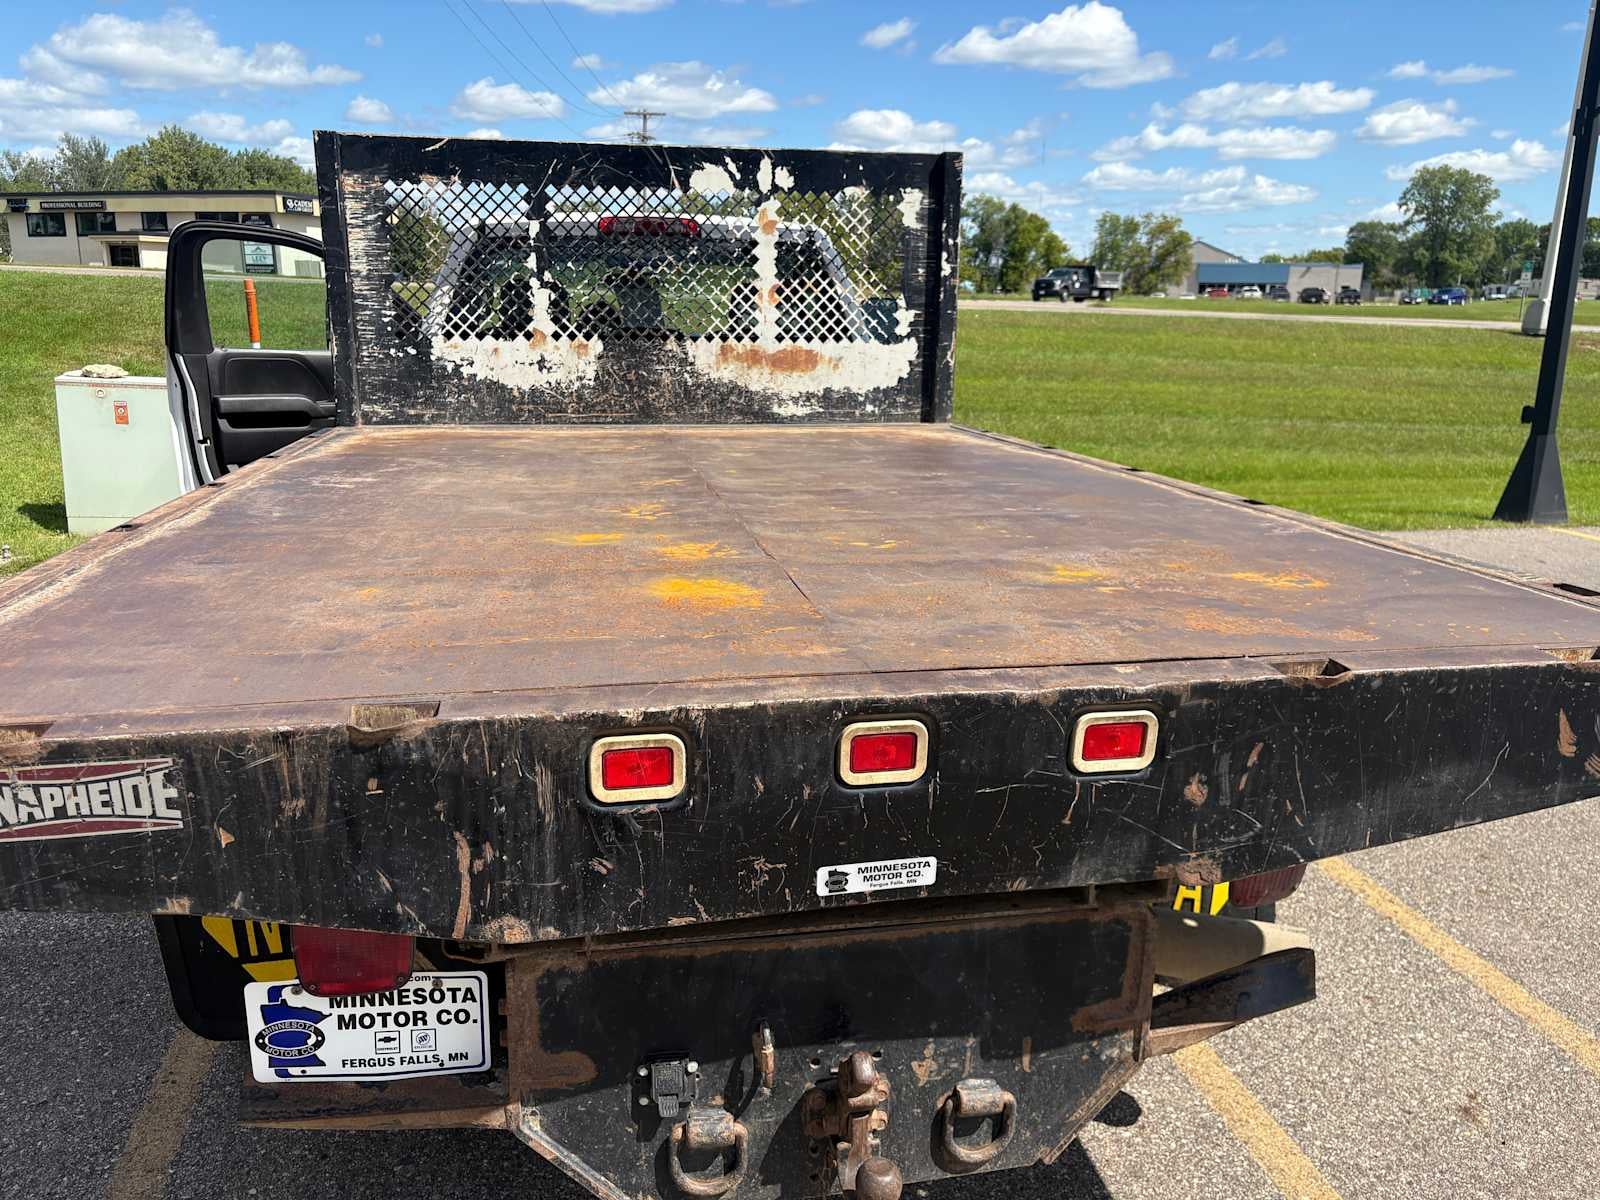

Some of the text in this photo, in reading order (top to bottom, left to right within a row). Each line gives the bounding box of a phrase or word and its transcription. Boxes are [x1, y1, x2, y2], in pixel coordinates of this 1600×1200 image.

[857, 861, 931, 874] MINNESOTA
[863, 870, 924, 882] MOTOR CO.
[329, 987, 478, 1008] MINNESOTA
[337, 1008, 478, 1030] MOTOR CO.
[262, 1022, 315, 1036] MINNESOTA
[265, 1046, 318, 1057] MOTOR CO.
[342, 1052, 469, 1068] FERGUS FALLS, MN
